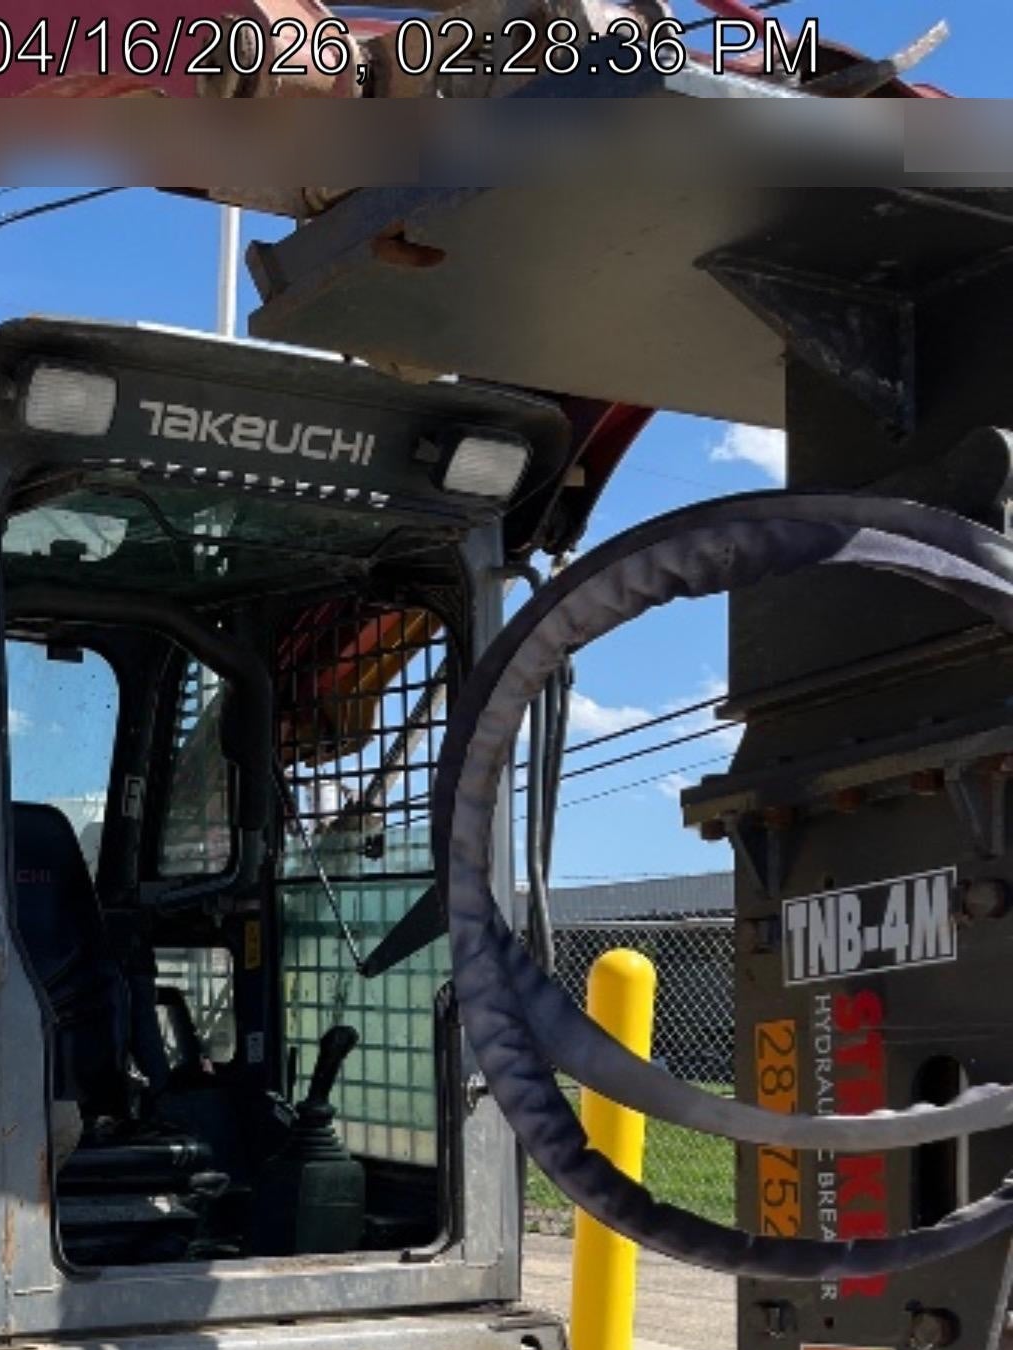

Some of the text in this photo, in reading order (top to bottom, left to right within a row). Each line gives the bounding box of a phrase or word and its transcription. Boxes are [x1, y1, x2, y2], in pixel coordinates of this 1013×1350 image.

[139, 400, 375, 466] TAKEUCHI
[788, 874, 951, 979] TNB-4M
[756, 1026, 800, 1240] 28752
